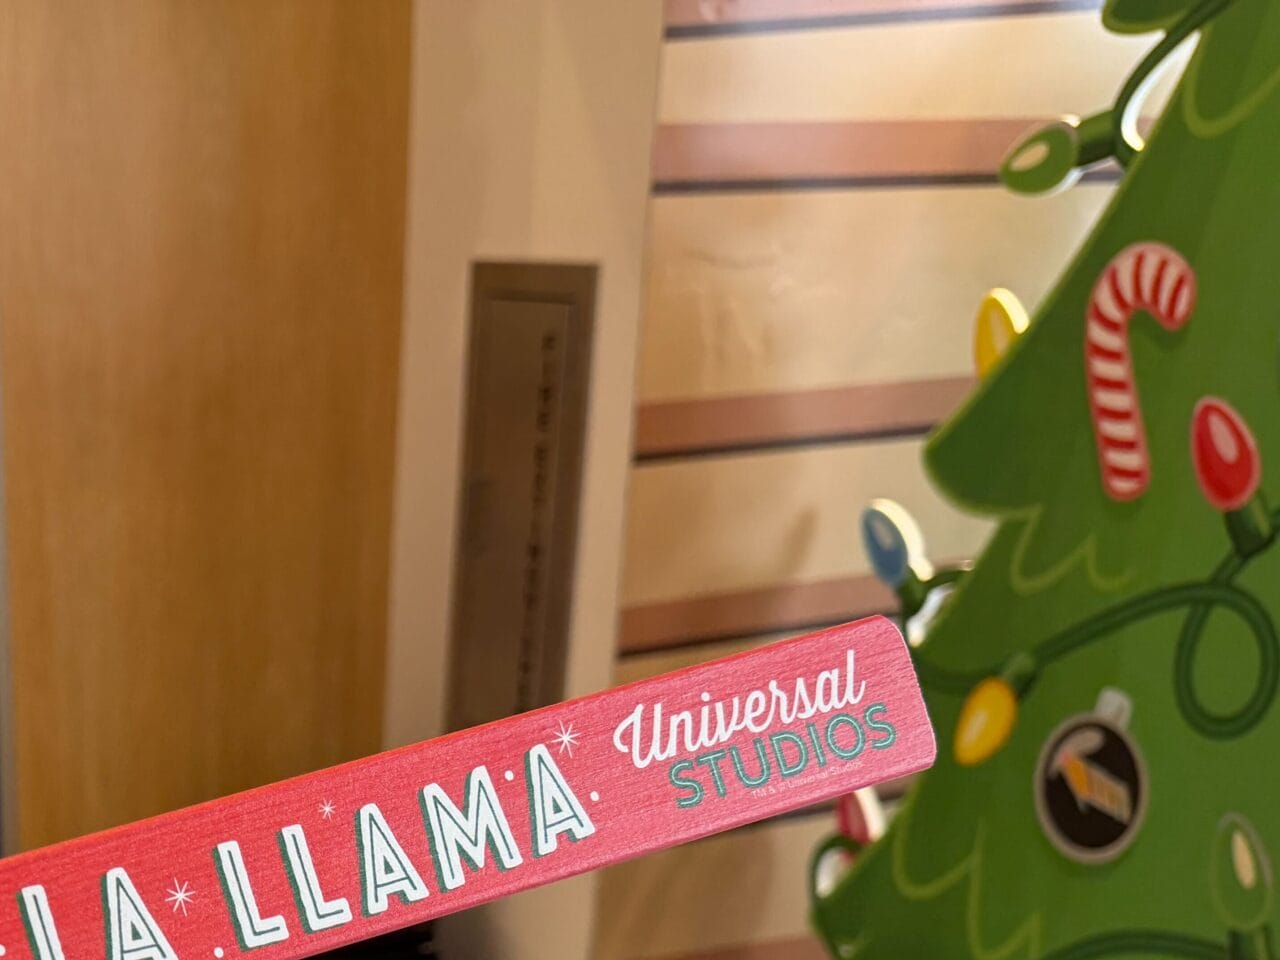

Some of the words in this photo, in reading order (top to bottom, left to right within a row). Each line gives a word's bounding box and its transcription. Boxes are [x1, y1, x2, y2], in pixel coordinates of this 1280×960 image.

[613, 649, 866, 769] Universal
[668, 703, 896, 808] STUDIOS
[212, 743, 596, 951] LLAMA
